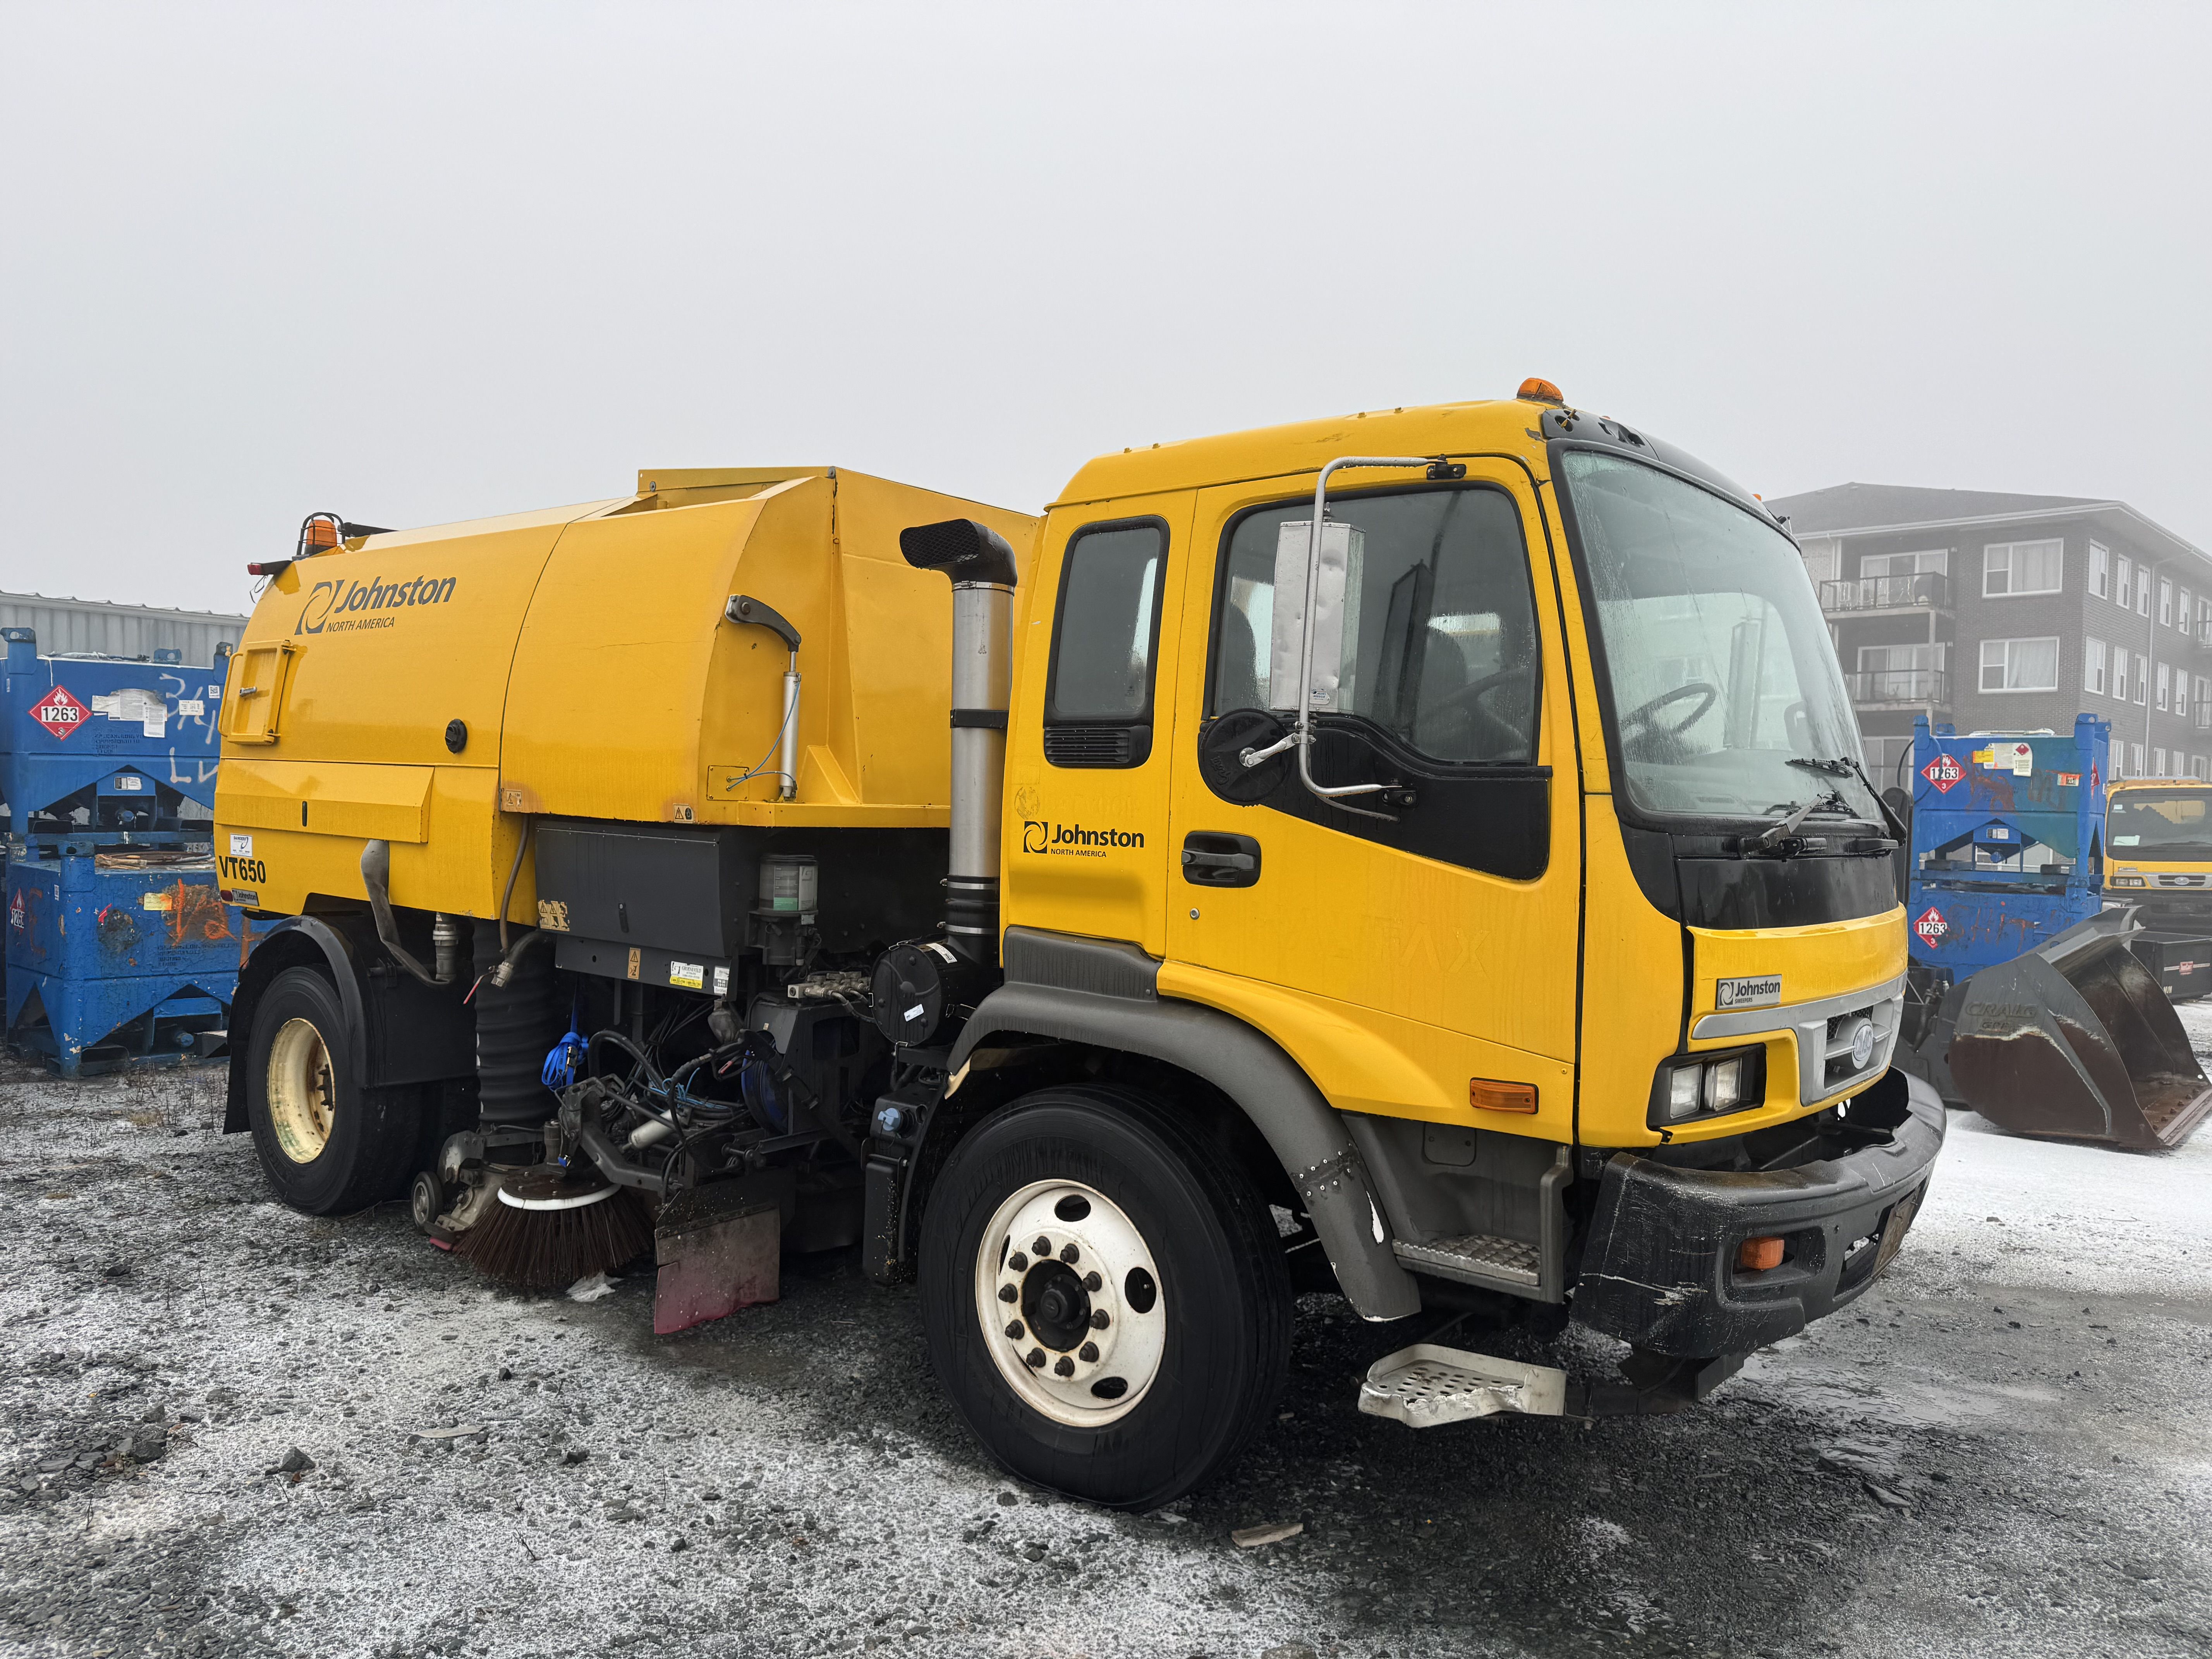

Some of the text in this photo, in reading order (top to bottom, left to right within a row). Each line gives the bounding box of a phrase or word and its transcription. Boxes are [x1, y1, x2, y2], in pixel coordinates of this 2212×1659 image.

[334, 575, 457, 613] Johnston
[326, 617, 395, 632] NORTH AMERICA
[43, 707, 77, 721] 1263
[1052, 824, 1144, 848] Johnston
[218, 855, 266, 884] VT650
[238, 891, 256, 900] Johnston
[1920, 922, 1946, 934] 1263
[1735, 980, 1781, 997] Johnston
[1966, 1002, 2038, 1018] CRAIG
